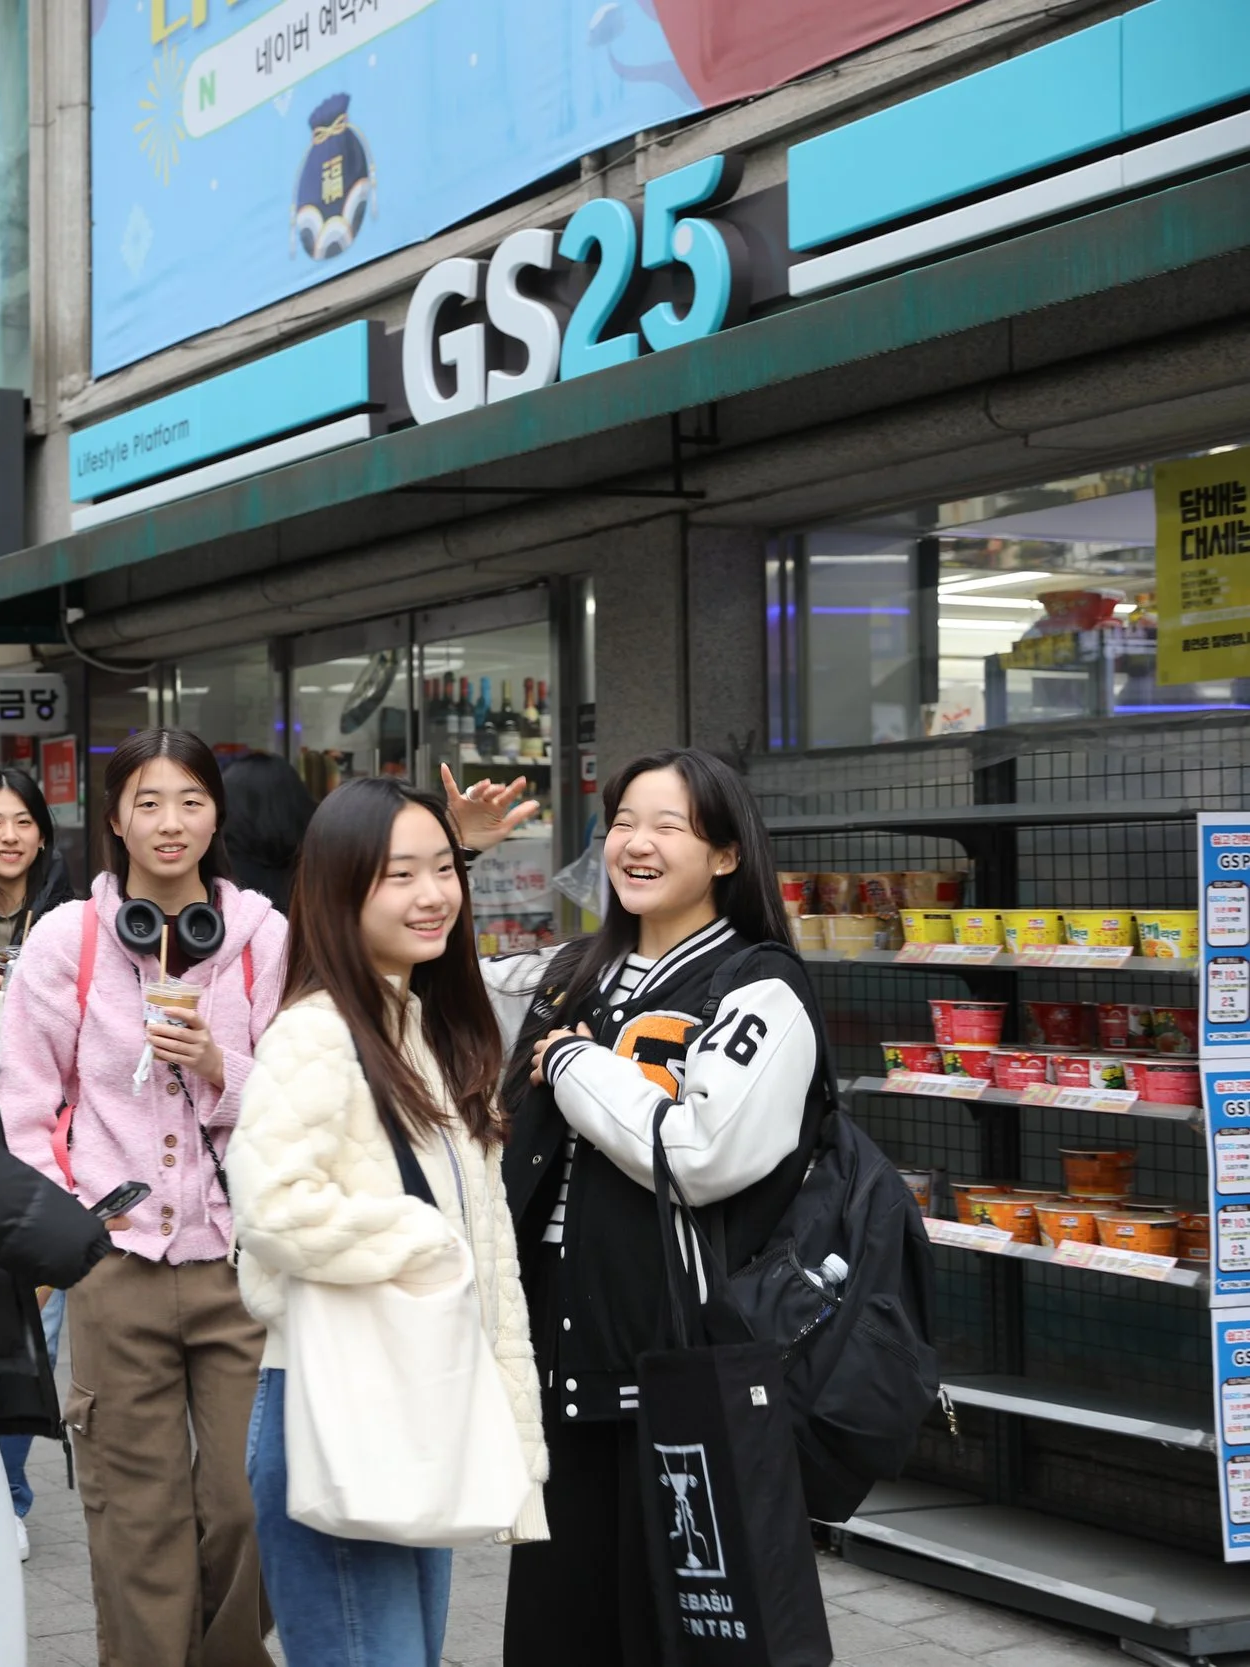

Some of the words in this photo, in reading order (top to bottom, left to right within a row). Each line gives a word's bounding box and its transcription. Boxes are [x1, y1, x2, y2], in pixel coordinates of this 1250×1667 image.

[255, 12, 310, 75] 네이버
[199, 70, 216, 112] N
[402, 154, 731, 426] GS25
[77, 441, 129, 477] Lifestyle
[133, 419, 190, 456] Platform
[1180, 480, 1247, 523] 담배는
[1181, 519, 1250, 561] 대세는
[132, 922, 147, 935] R
